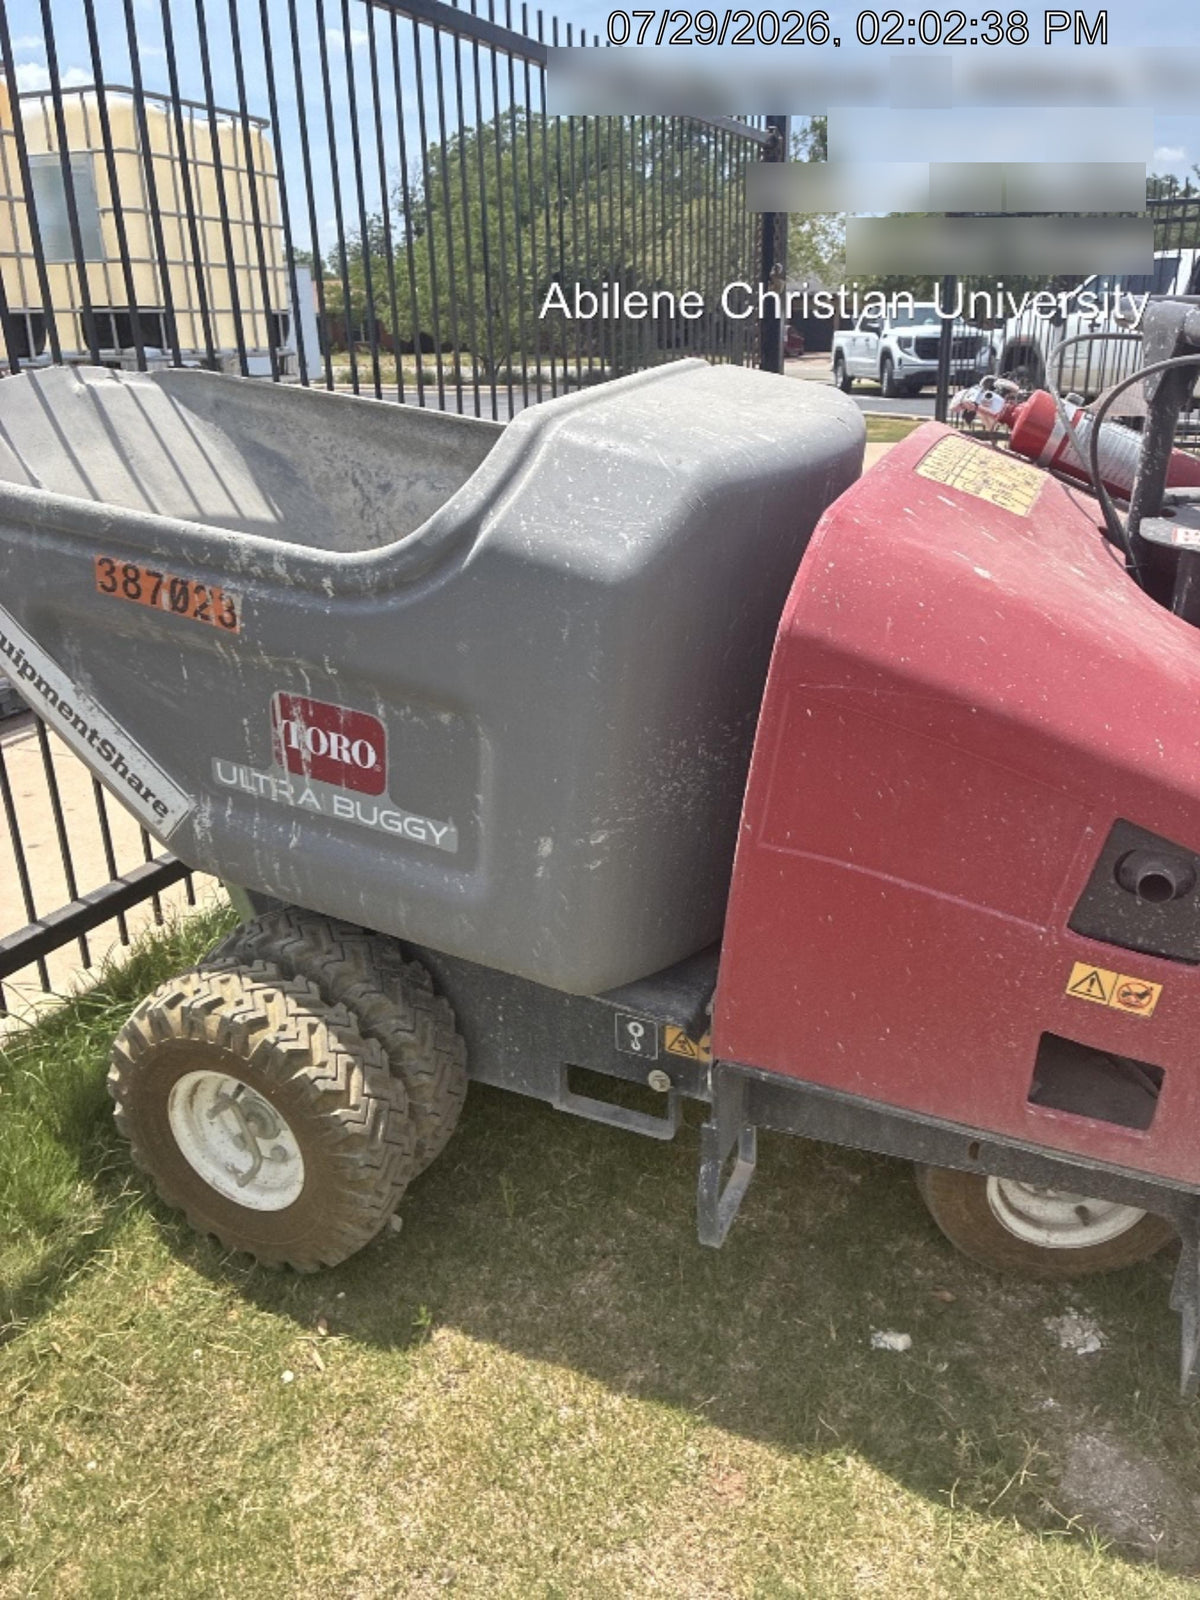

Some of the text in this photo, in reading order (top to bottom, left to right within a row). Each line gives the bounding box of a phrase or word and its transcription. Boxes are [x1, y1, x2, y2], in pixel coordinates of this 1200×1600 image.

[98, 557, 238, 629] 387023
[0, 630, 169, 818] uipmentShare
[281, 719, 377, 769] TORO
[216, 762, 450, 846] ULTRA BUGGY
